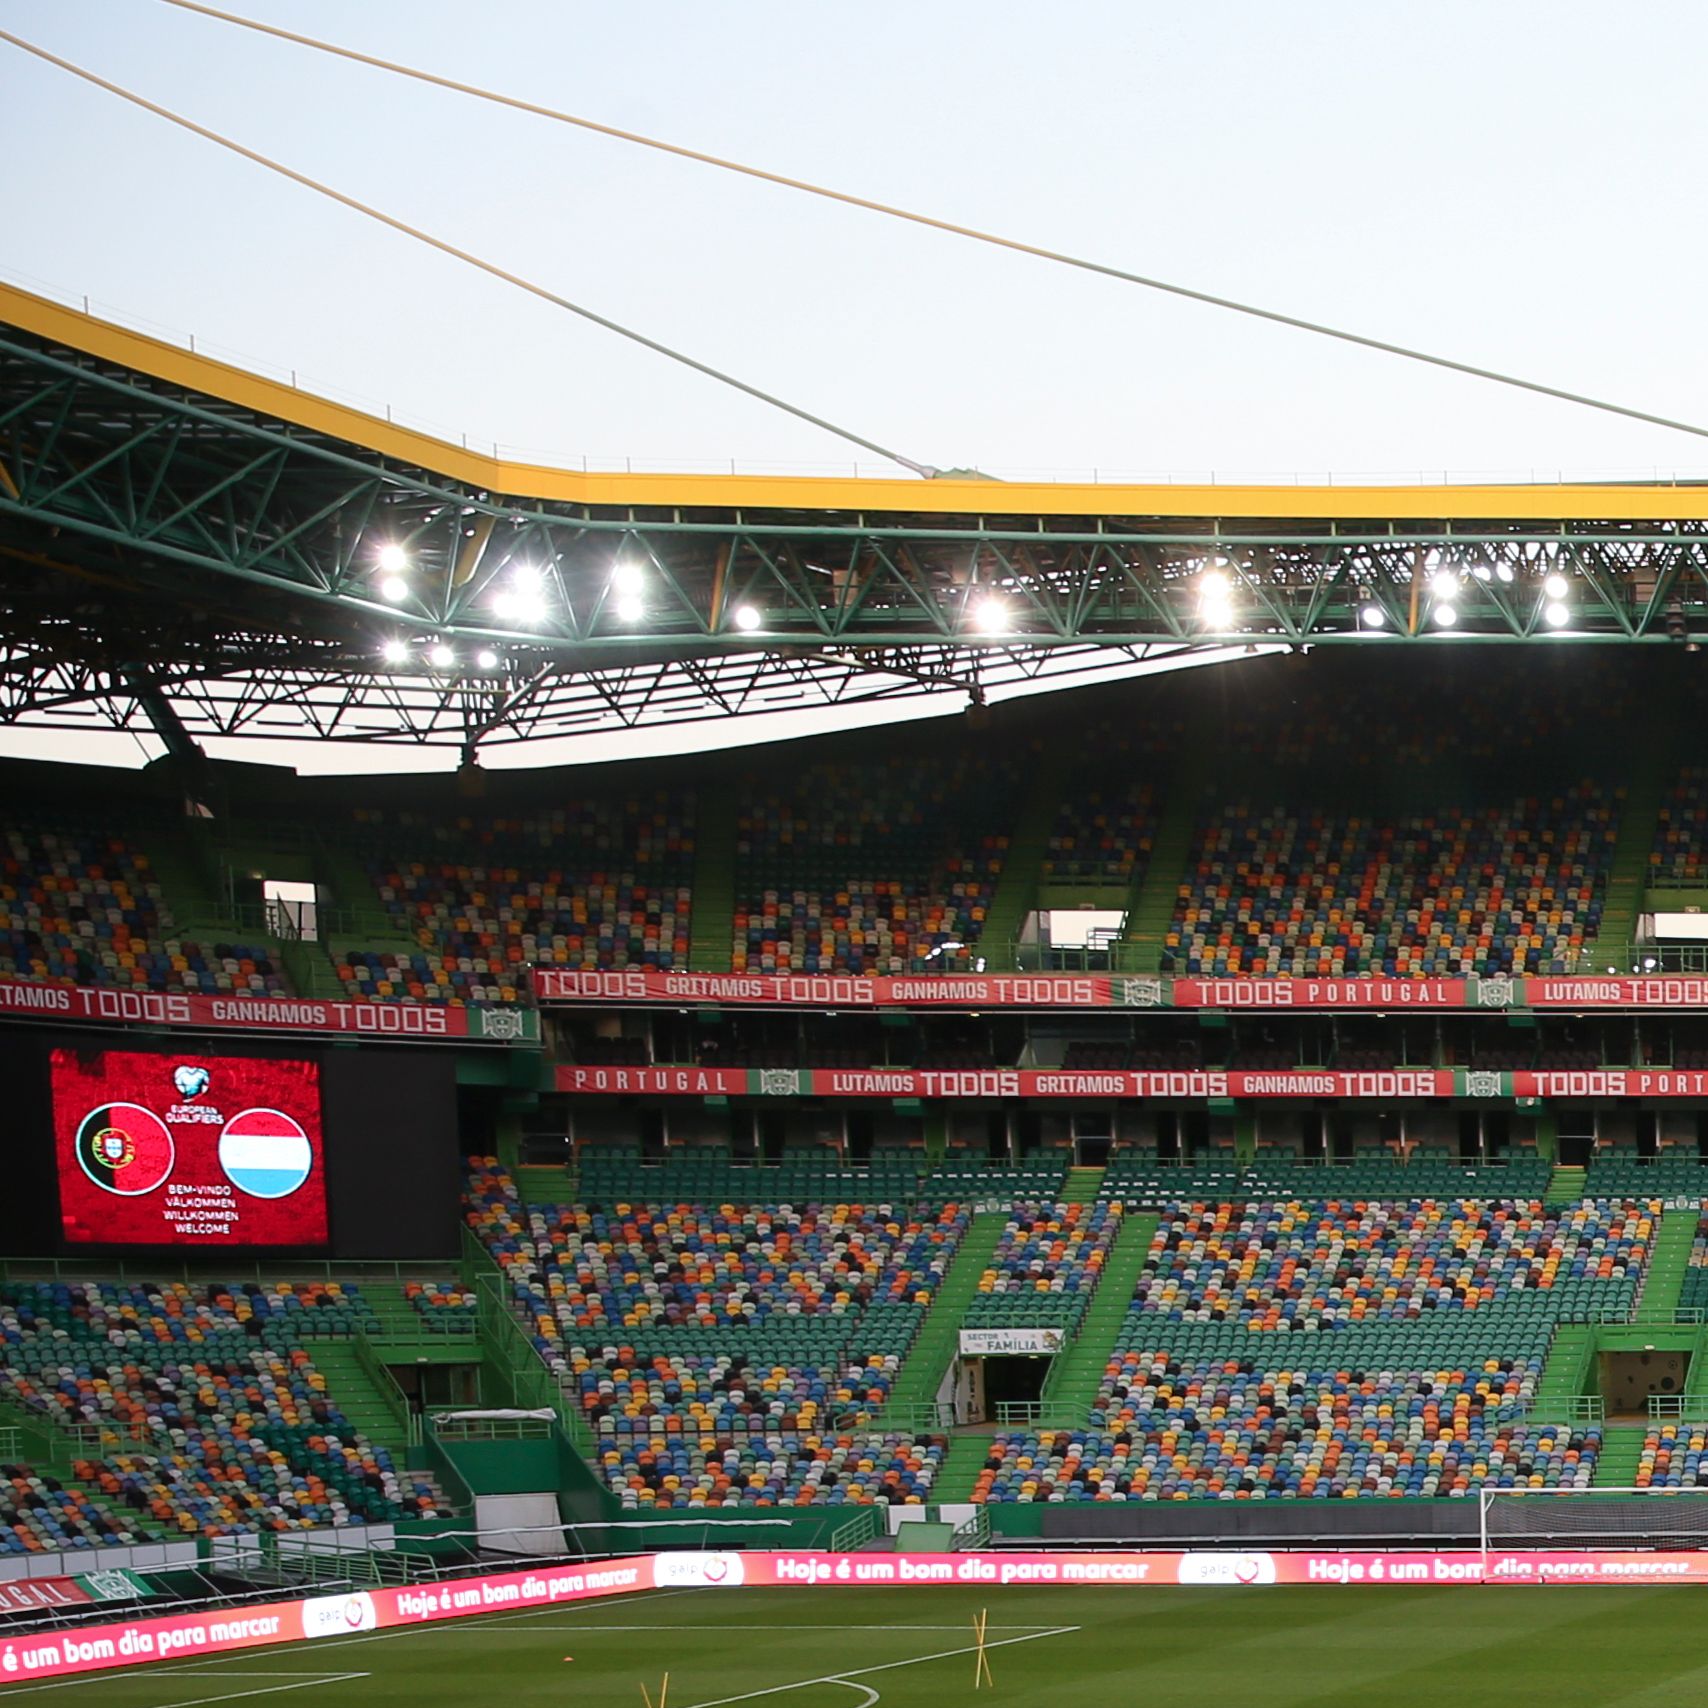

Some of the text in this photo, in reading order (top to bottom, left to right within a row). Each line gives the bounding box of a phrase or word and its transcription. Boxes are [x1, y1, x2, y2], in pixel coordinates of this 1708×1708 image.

[538, 971, 1092, 1004] TODOS GRITAMOS TODOS GANHAMOS TODOS
[1195, 981, 1446, 1004] TODOS PORTUGAL
[1544, 983, 1621, 1001] LUTAMOS
[77, 989, 446, 1034] TODOS GANHAMOS TODOS
[575, 1071, 727, 1090] PORTUGAL
[834, 1072, 1436, 1096] LUTAMOS TODOS GRITAMOS TODOS GANHAMOS TODOS
[1530, 1072, 1626, 1096] TODOS
[165, 1113, 224, 1124] QUALIFIERS
[171, 1104, 218, 1114] EUROPEAN
[168, 1184, 231, 1196] BEM-VINDO
[163, 1210, 239, 1221] WILLKOMMEN
[175, 1223, 230, 1234] WELCOME
[967, 1333, 998, 1341] SECTOR
[987, 1338, 1038, 1351] FAMÍLIA
[777, 1558, 1151, 1584] Hoje é um bom dia para marcar
[1309, 1557, 1364, 1583] Hoje
[1369, 1557, 1384, 1579] é
[1390, 1563, 1428, 1579] um
[1434, 1557, 1487, 1579] bom
[398, 1567, 638, 1618] Hoje é um bom dia para marcar
[3, 1615, 280, 1672] é um bom dia para marcar
